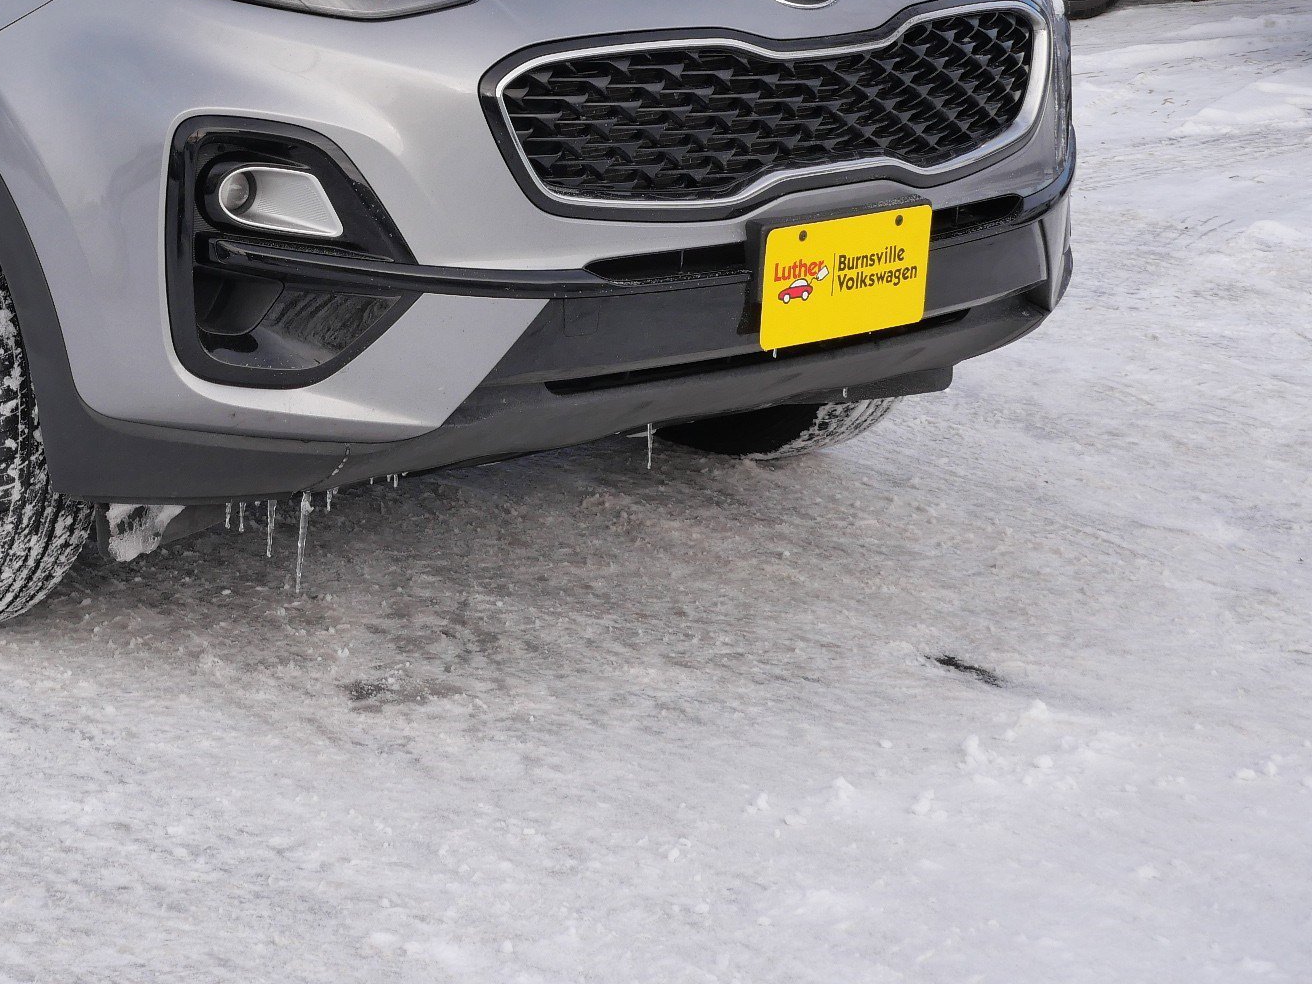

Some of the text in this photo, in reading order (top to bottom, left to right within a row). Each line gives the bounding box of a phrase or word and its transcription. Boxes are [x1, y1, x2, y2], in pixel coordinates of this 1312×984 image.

[773, 245, 906, 283] Luther Burnsville
[837, 264, 918, 293] Volkswagen
